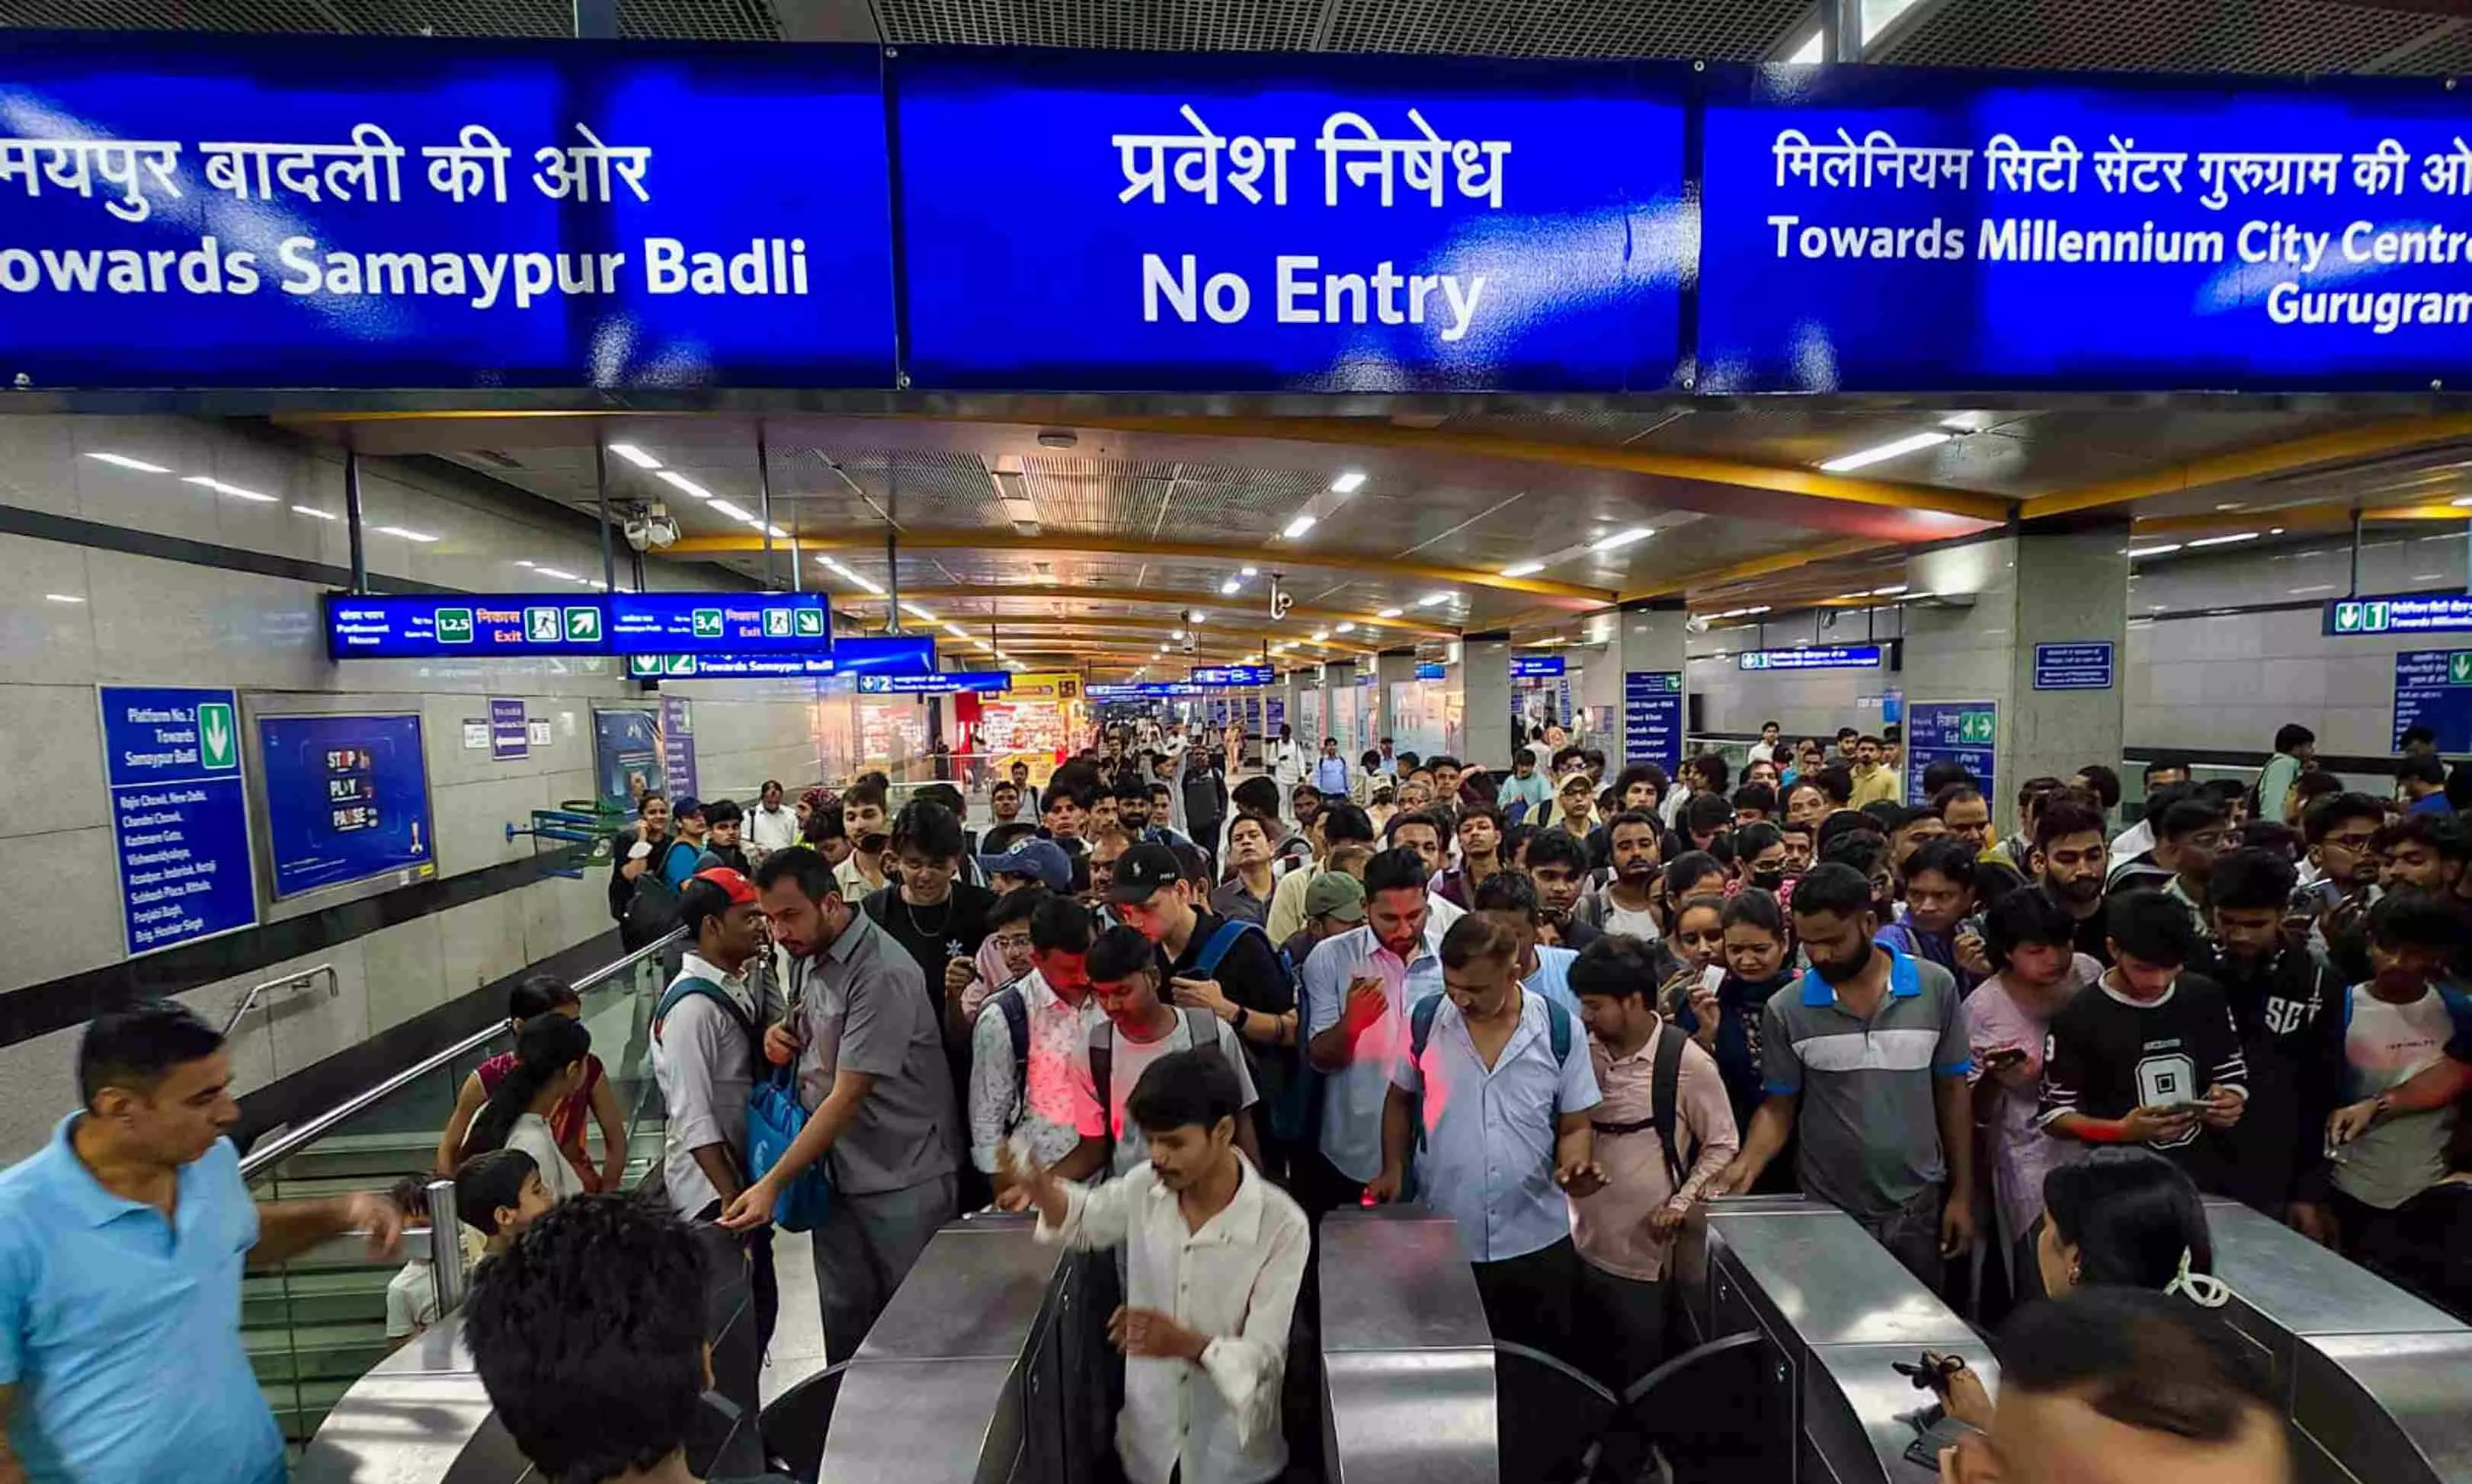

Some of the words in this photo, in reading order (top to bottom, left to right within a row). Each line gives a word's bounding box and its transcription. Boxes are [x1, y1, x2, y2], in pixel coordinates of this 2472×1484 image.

[200, 123, 405, 203] बादली
[422, 124, 511, 202] की
[533, 123, 651, 202] ओर
[1113, 104, 1295, 205] प्रवेश
[1316, 109, 1511, 207] निषेध
[1772, 128, 1973, 190] मिलेनियम
[1984, 134, 2083, 193] सिटी
[2094, 134, 2188, 193] सेंटर
[2198, 153, 2342, 210] गुरुग्राम
[2352, 139, 2410, 195] की
[1768, 215, 1964, 260] Towards
[1977, 219, 2224, 263] Millennium
[2236, 220, 2330, 274] City
[2342, 220, 2472, 264] Centr
[278, 237, 626, 309] Samaypur
[645, 238, 808, 295] Badli
[1143, 254, 1250, 323] No
[1276, 255, 1487, 342] Entry
[476, 608, 520, 624] निकास
[494, 629, 523, 642] Exit
[739, 626, 760, 638] Exit
[699, 661, 747, 673] Towards
[127, 708, 171, 723] Platform
[187, 708, 195, 722] 2
[154, 728, 196, 744] Towards
[125, 751, 174, 768] Samaypur
[174, 748, 198, 763] Badli
